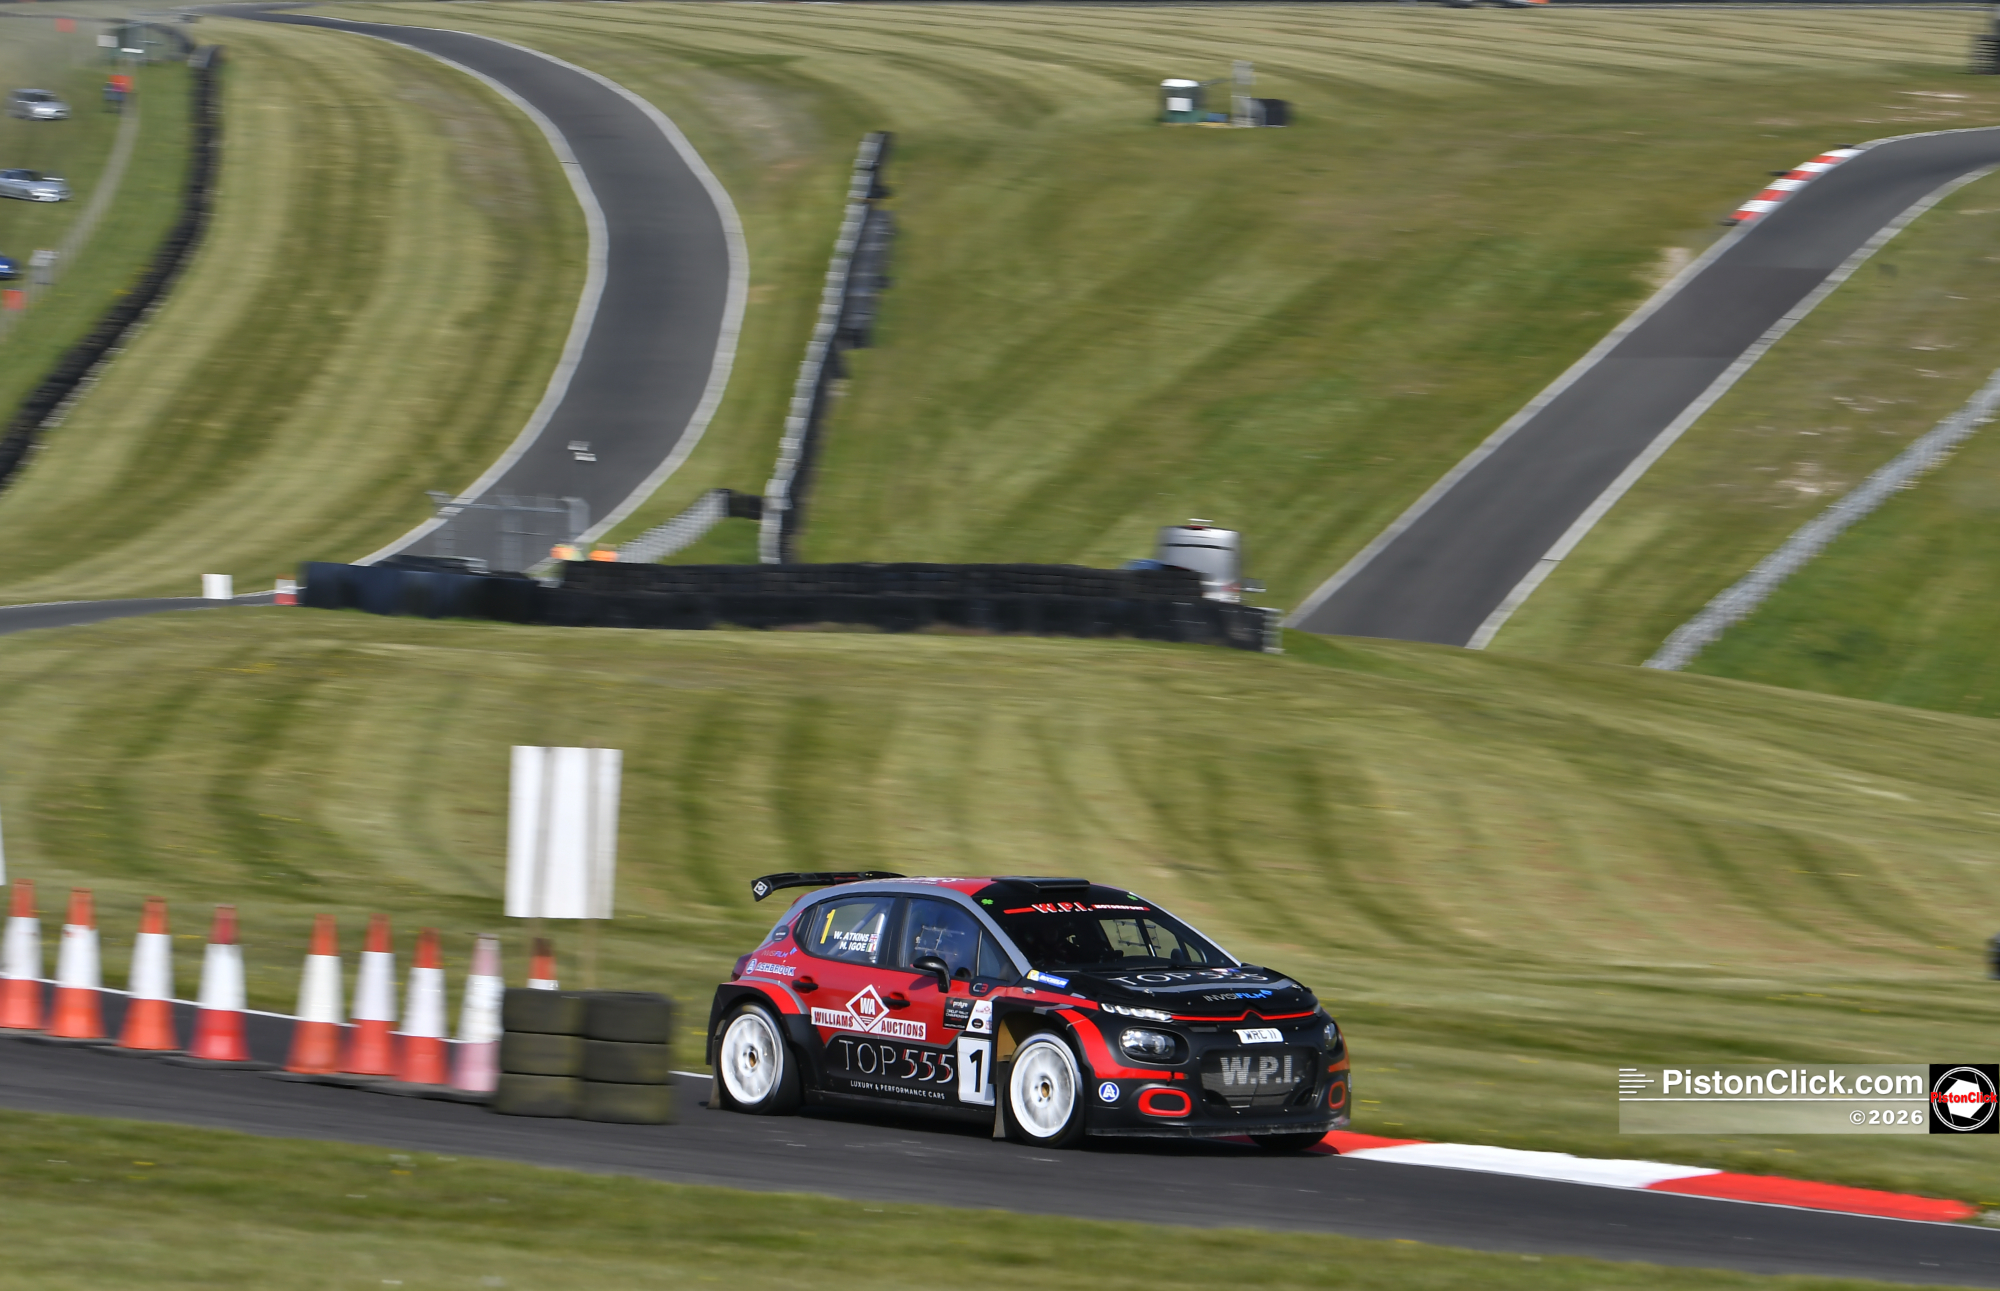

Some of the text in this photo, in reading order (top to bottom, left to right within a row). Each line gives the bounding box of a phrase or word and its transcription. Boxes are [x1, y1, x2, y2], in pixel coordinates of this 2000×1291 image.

[1031, 901, 1093, 914] W.P.I.
[820, 908, 836, 944] 1
[833, 930, 869, 942] W. ATKINS
[838, 941, 866, 951] M. IGOE
[755, 962, 796, 976] ASHBROOK
[1107, 969, 1269, 986] TOP 555
[972, 982, 989, 993] C3
[1203, 990, 1265, 1002] INVISIFILM
[859, 997, 876, 1016] WA
[813, 1010, 854, 1028] WILLIAMS
[881, 1021, 924, 1038] AUCTIONS
[1243, 1030, 1267, 1041] WRC
[838, 1039, 955, 1084] TOP 555
[969, 1049, 984, 1093] 1
[1219, 1054, 1302, 1087] W.P.I.
[850, 1080, 874, 1090] LUXURY
[880, 1084, 927, 1098] PERFORMANCE
[928, 1091, 945, 1100] CARS
